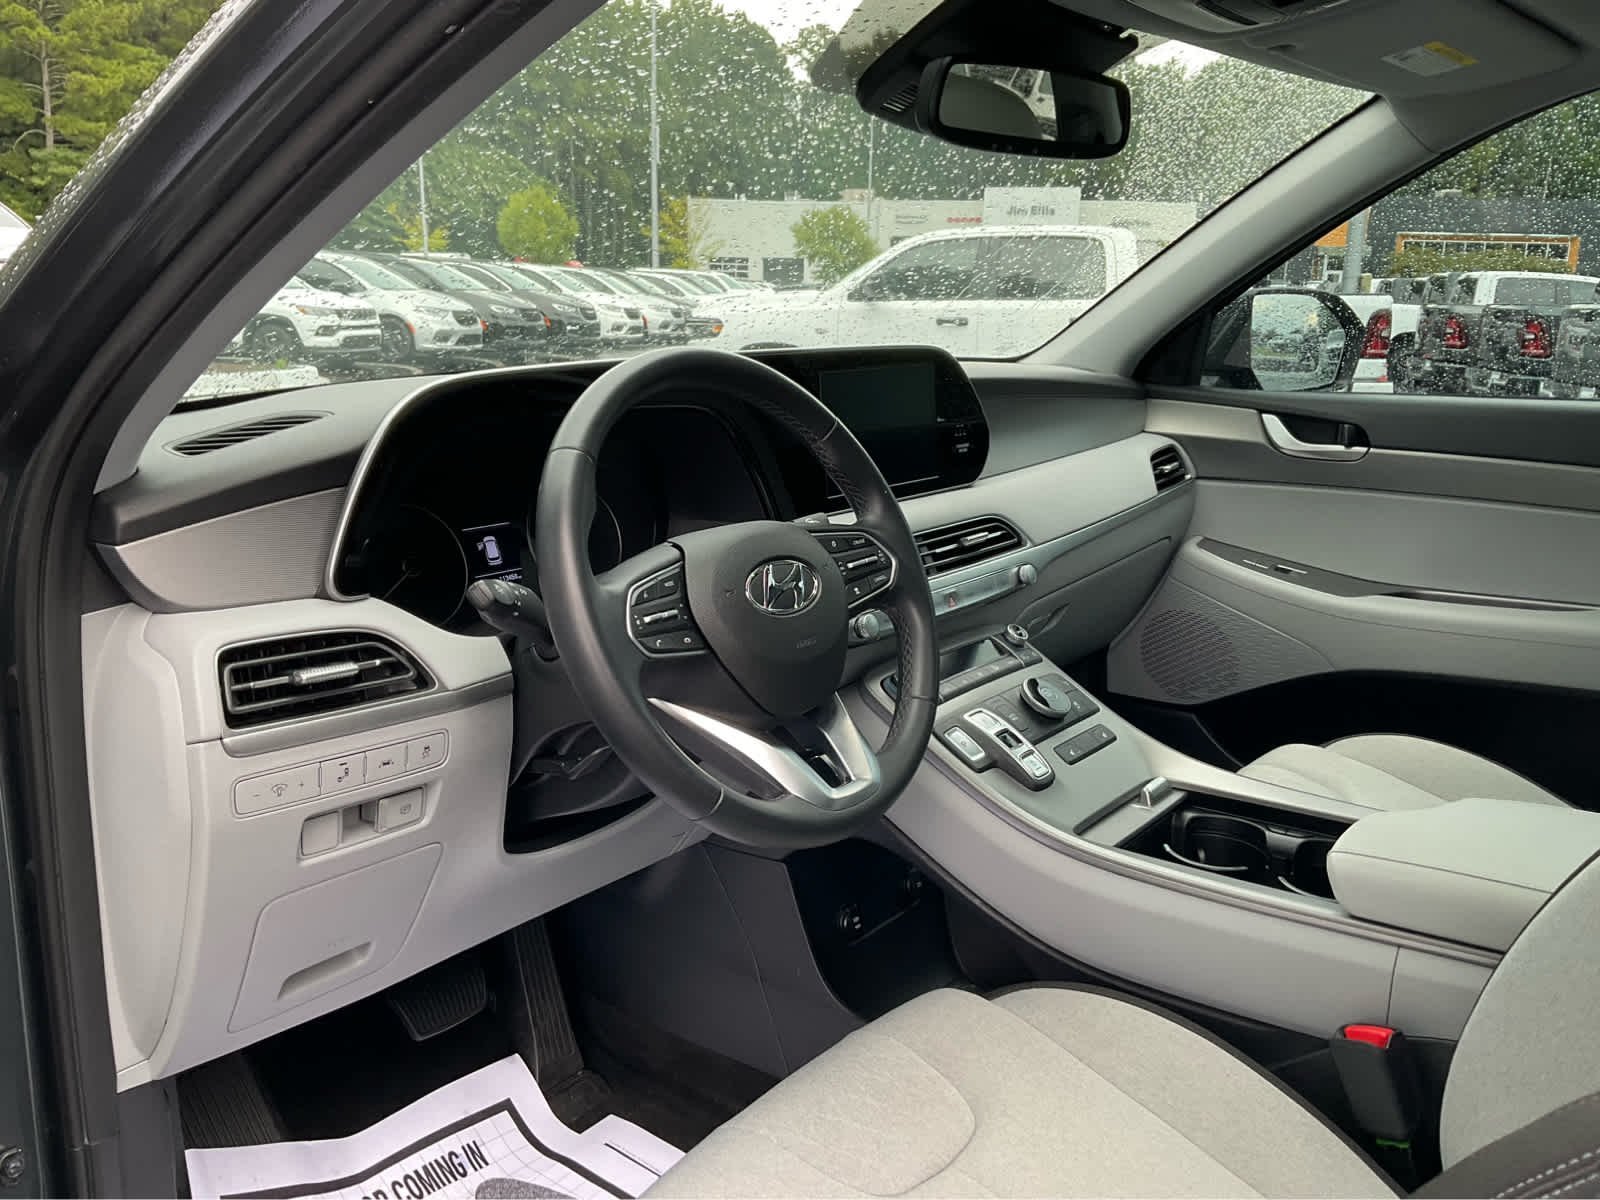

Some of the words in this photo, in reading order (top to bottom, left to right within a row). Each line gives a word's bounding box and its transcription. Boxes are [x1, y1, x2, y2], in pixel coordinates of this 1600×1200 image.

[1006, 205, 1028, 216] Jim
[1030, 205, 1056, 216] Ellis
[390, 1150, 468, 1200] COMING
[461, 1140, 490, 1172] IN
